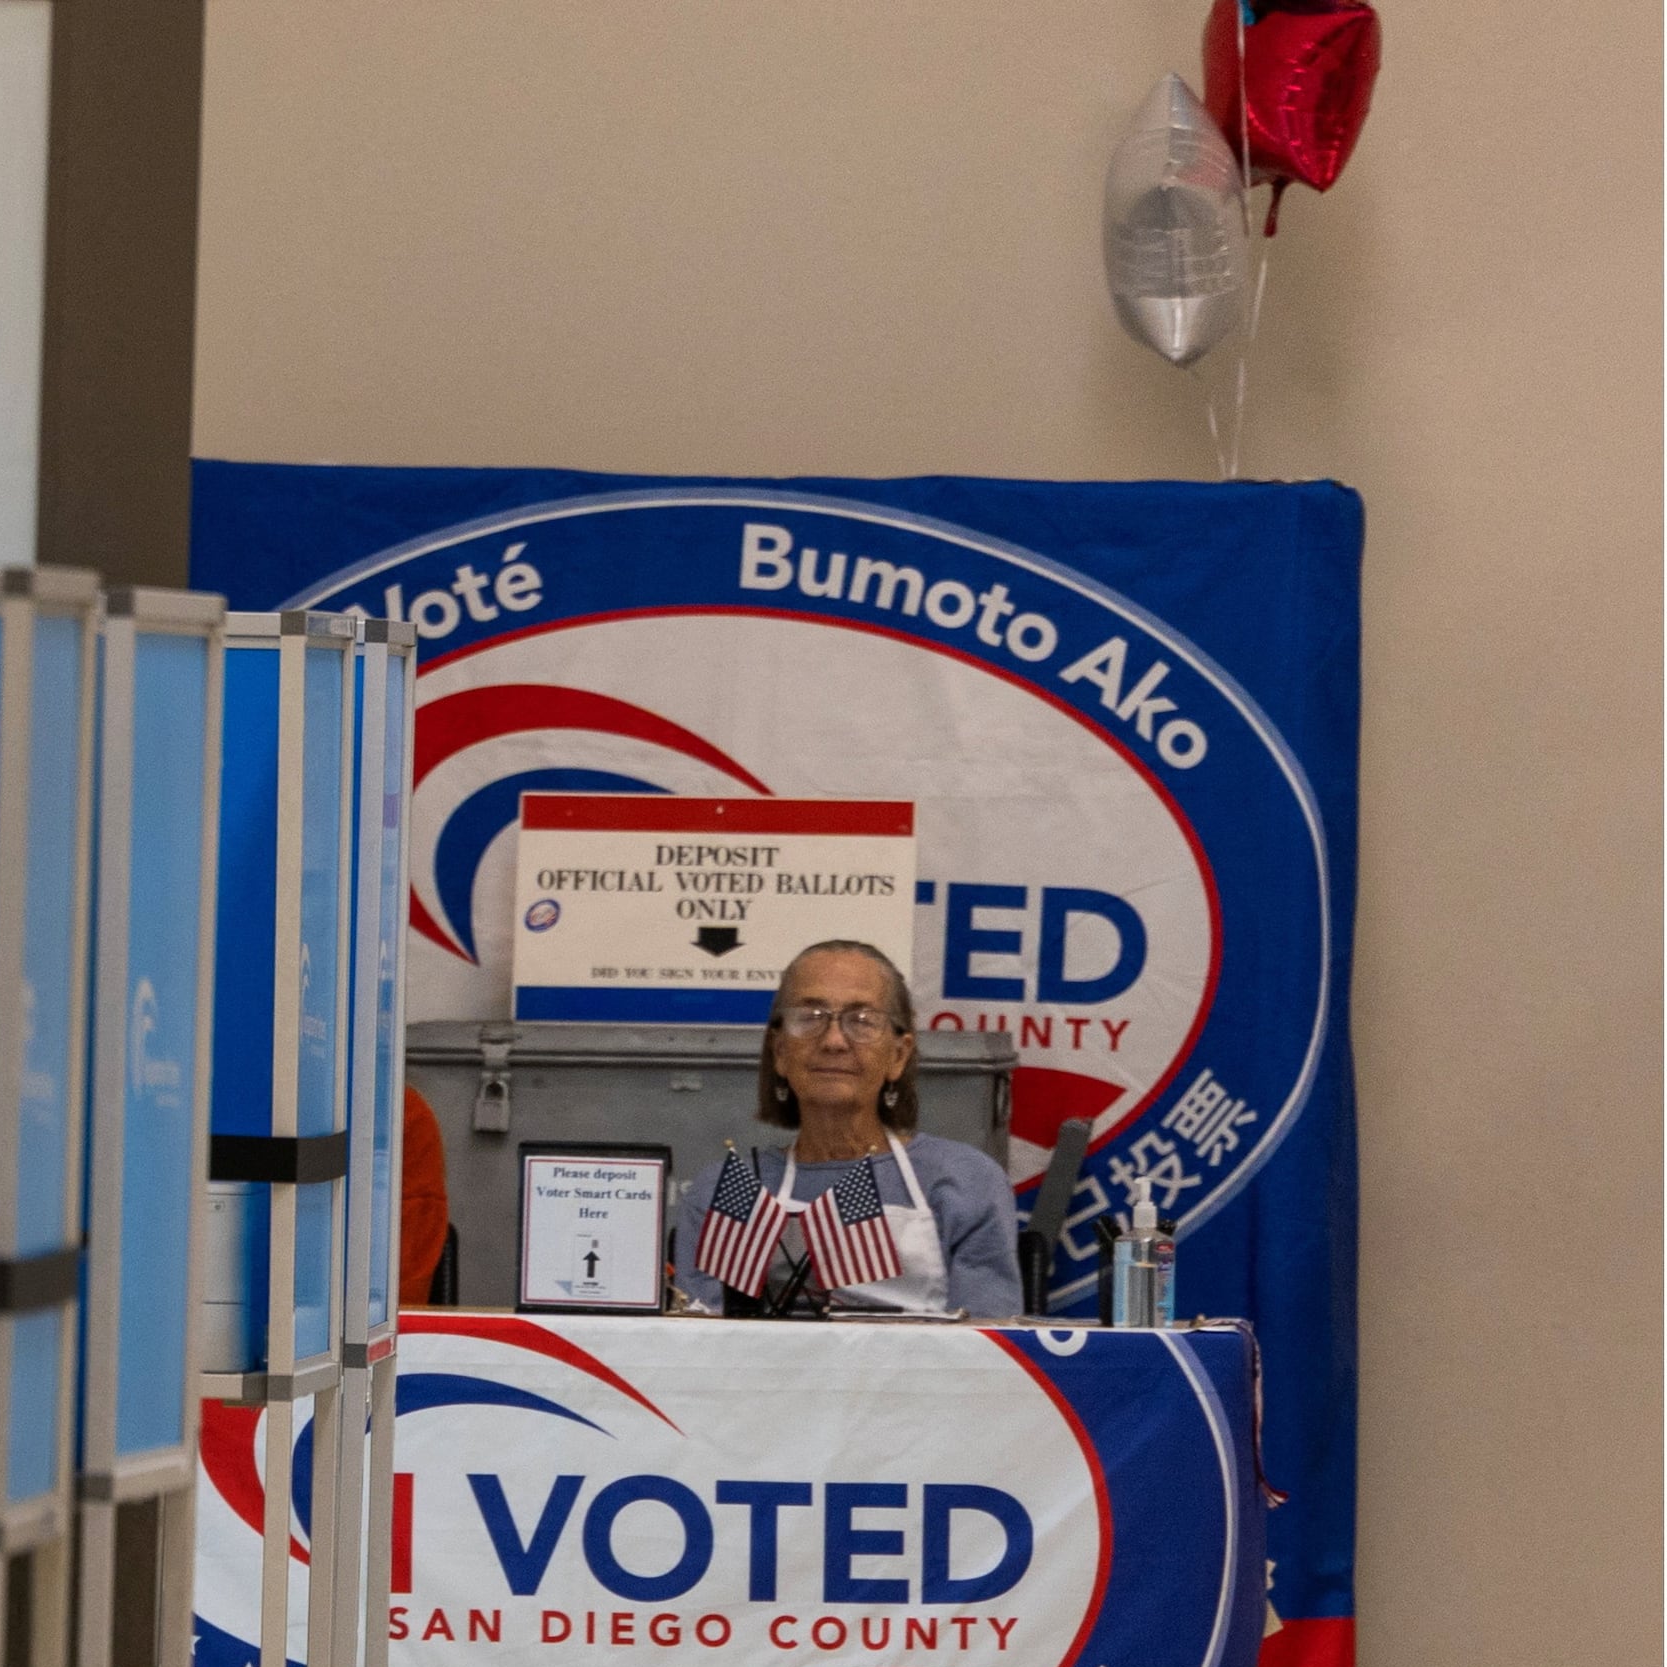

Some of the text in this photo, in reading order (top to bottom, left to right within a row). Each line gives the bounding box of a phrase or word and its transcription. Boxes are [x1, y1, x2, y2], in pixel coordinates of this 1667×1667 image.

[739, 523, 1208, 769] Bumoto Ako
[656, 845, 779, 867] DEPOSIT
[537, 869, 895, 896] OFFICIAL VOTED BALLOTS
[676, 898, 752, 920] ONLY
[553, 1167, 637, 1182] Please deposit
[536, 1186, 652, 1201] Voter Smart Cards
[578, 1207, 609, 1219] Here
[390, 1472, 1034, 1604] I VOTED
[388, 1607, 1020, 1651] SAN DIEGO COUNTY
